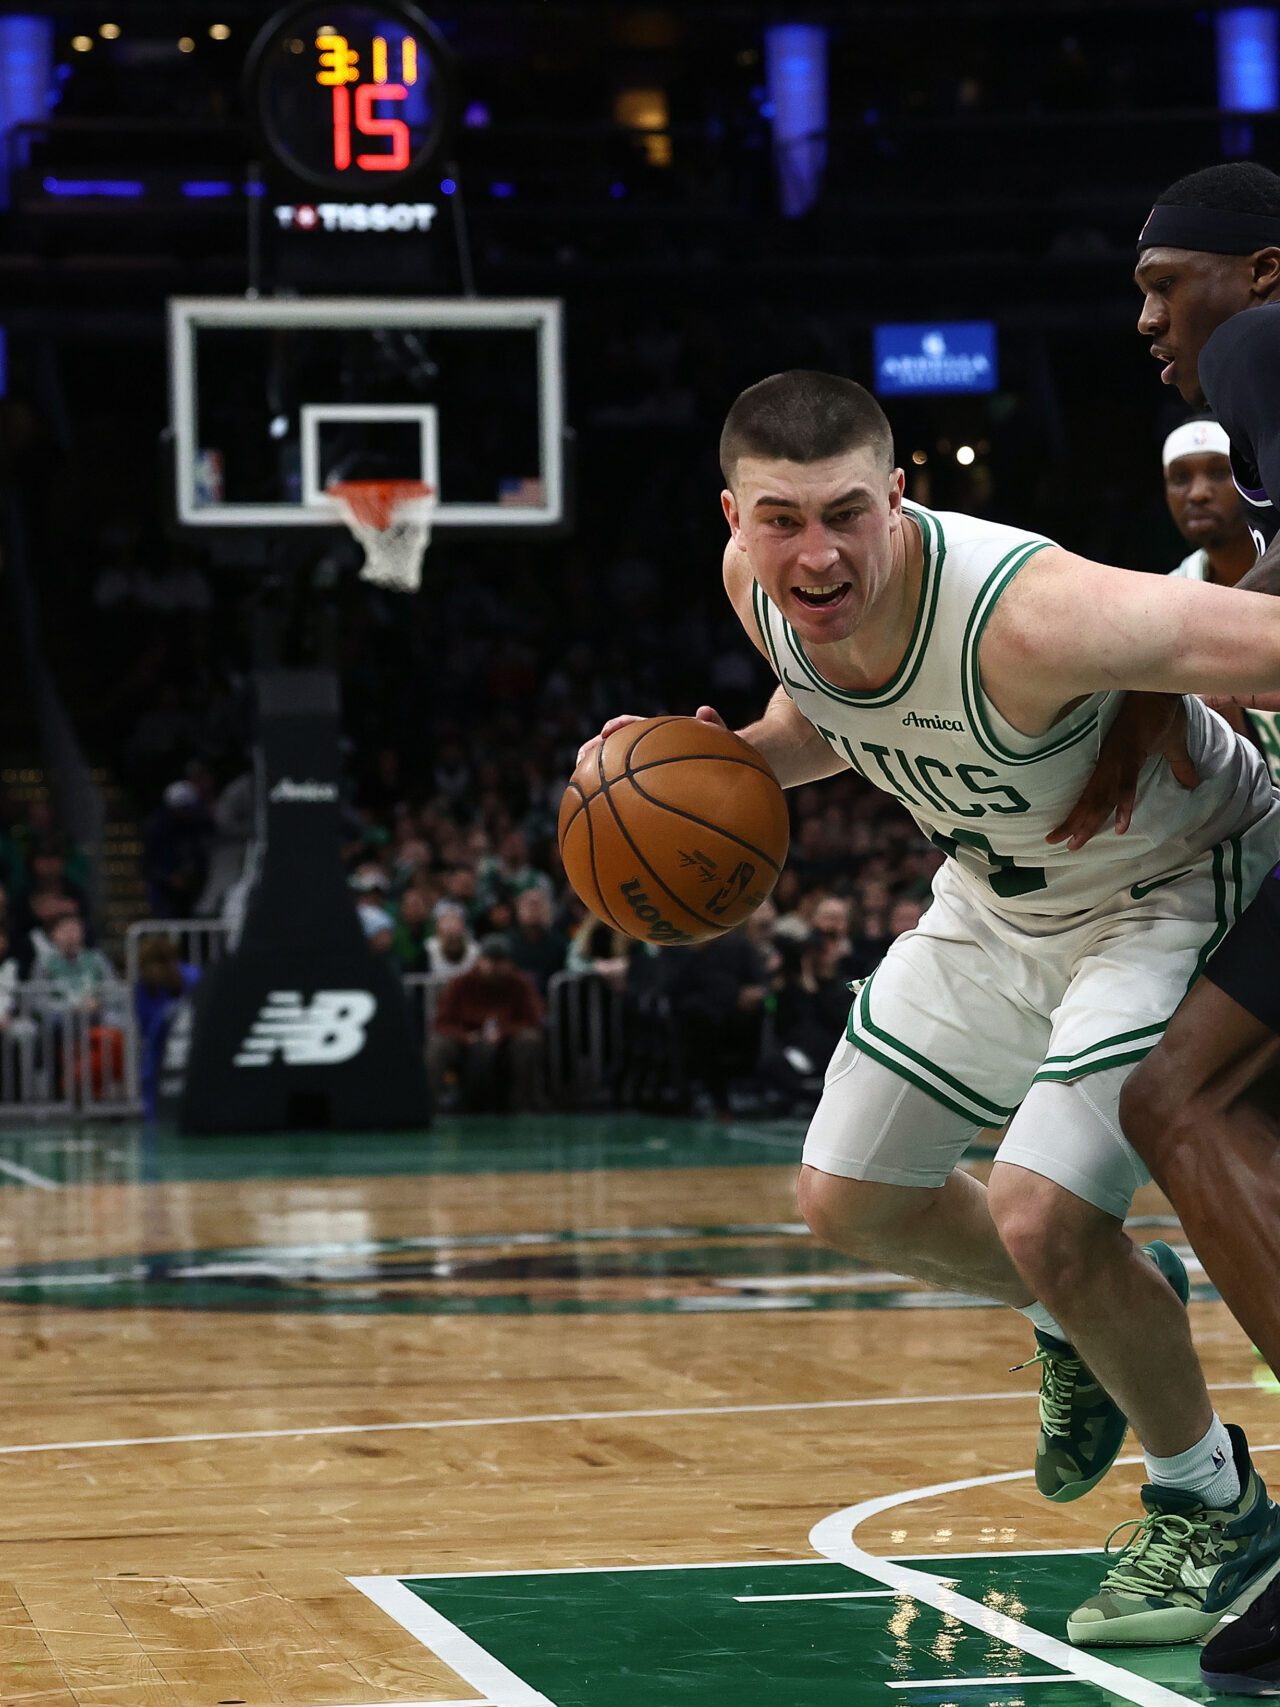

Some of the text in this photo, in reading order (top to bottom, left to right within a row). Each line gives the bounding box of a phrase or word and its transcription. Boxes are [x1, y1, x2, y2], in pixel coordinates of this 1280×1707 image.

[332, 83, 411, 171] 15
[318, 202, 438, 232] TISSOT
[901, 711, 965, 733] Amica
